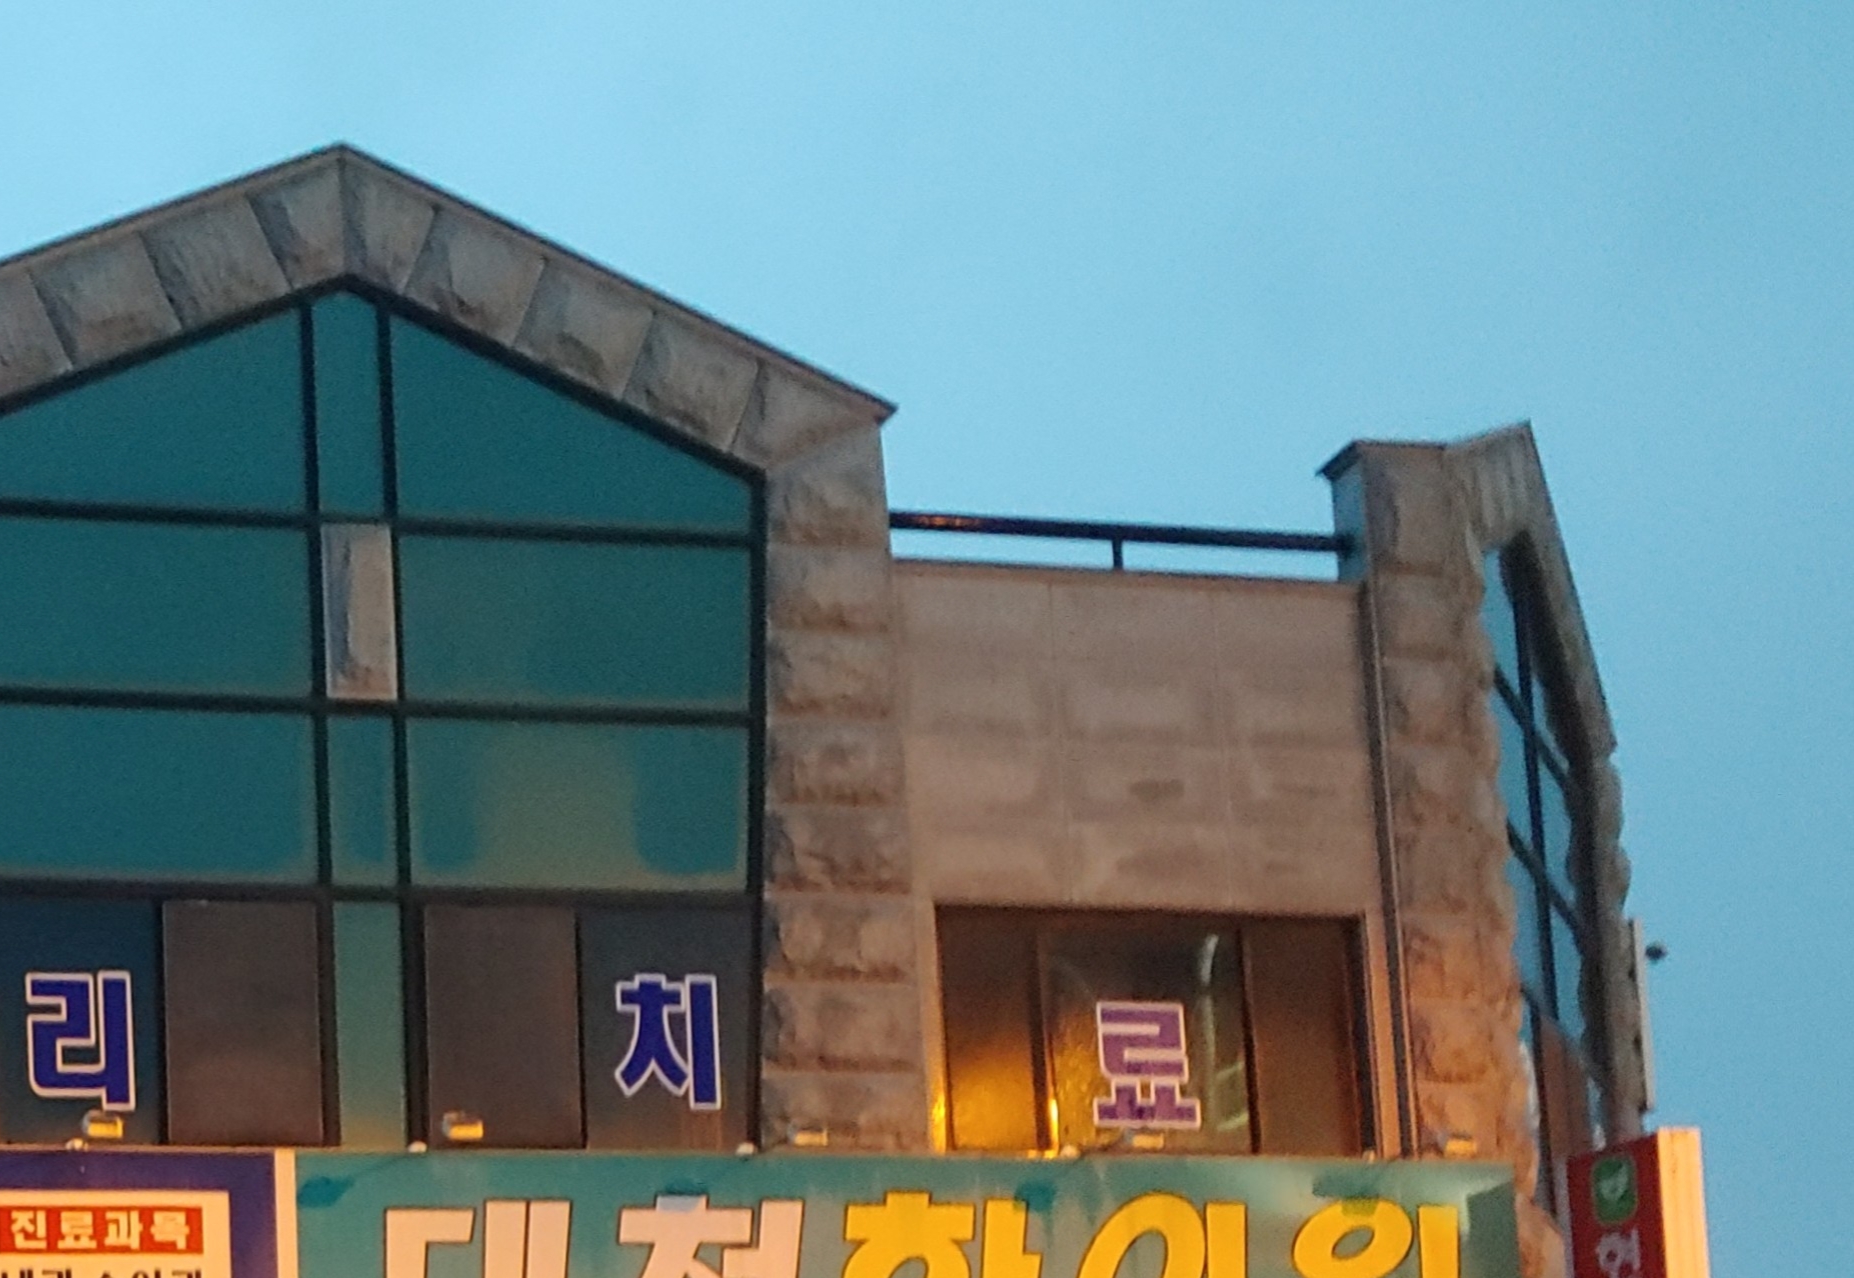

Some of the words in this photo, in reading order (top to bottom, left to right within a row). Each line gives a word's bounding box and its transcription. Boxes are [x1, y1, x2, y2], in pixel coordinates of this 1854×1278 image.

[25, 970, 135, 1111] 리
[614, 974, 721, 1110] 치
[1093, 1001, 1201, 1129] 료
[10, 1209, 190, 1250] 진료과목
